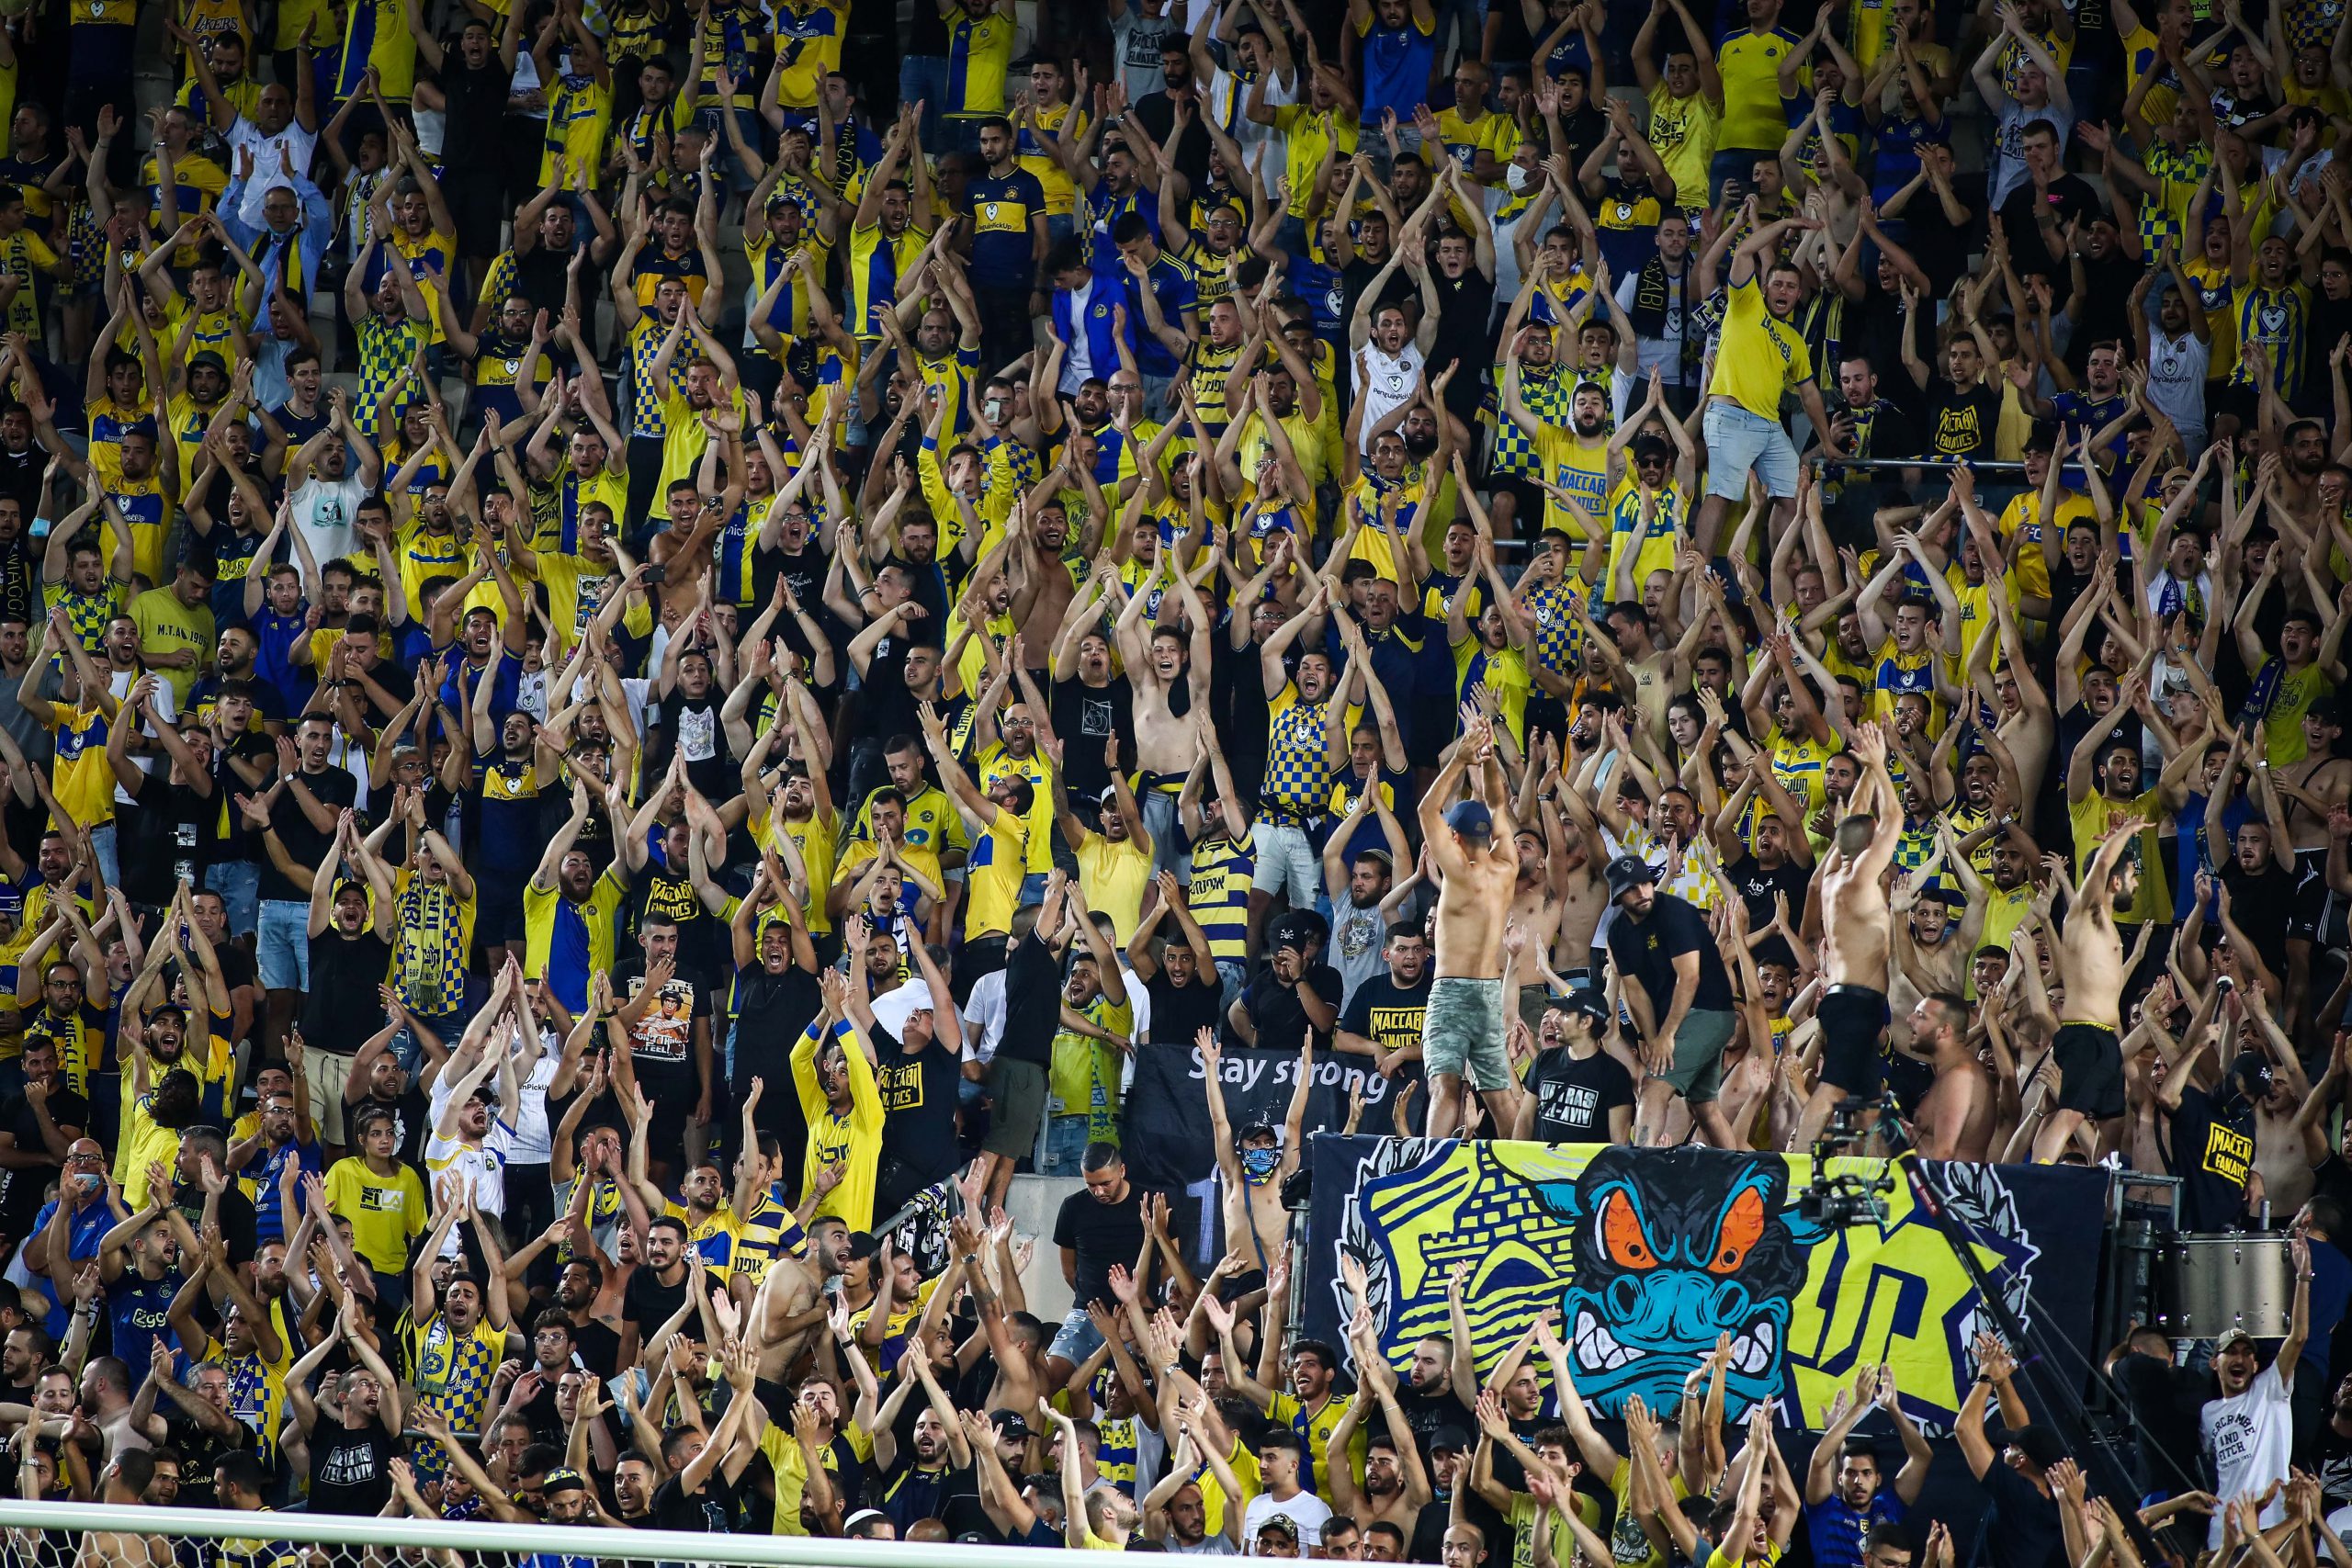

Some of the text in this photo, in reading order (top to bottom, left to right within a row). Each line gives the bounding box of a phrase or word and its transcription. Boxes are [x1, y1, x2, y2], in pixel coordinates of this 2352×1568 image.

[193, 13, 239, 33] LAKERS
[1559, 469, 1606, 497] MACCAB
[645, 1042, 671, 1055] FEEL!
[1188, 1046, 1388, 1104] Stay strong
[133, 1308, 167, 1328] Zigg
[324, 1462, 373, 1483] TEL-AVIV
